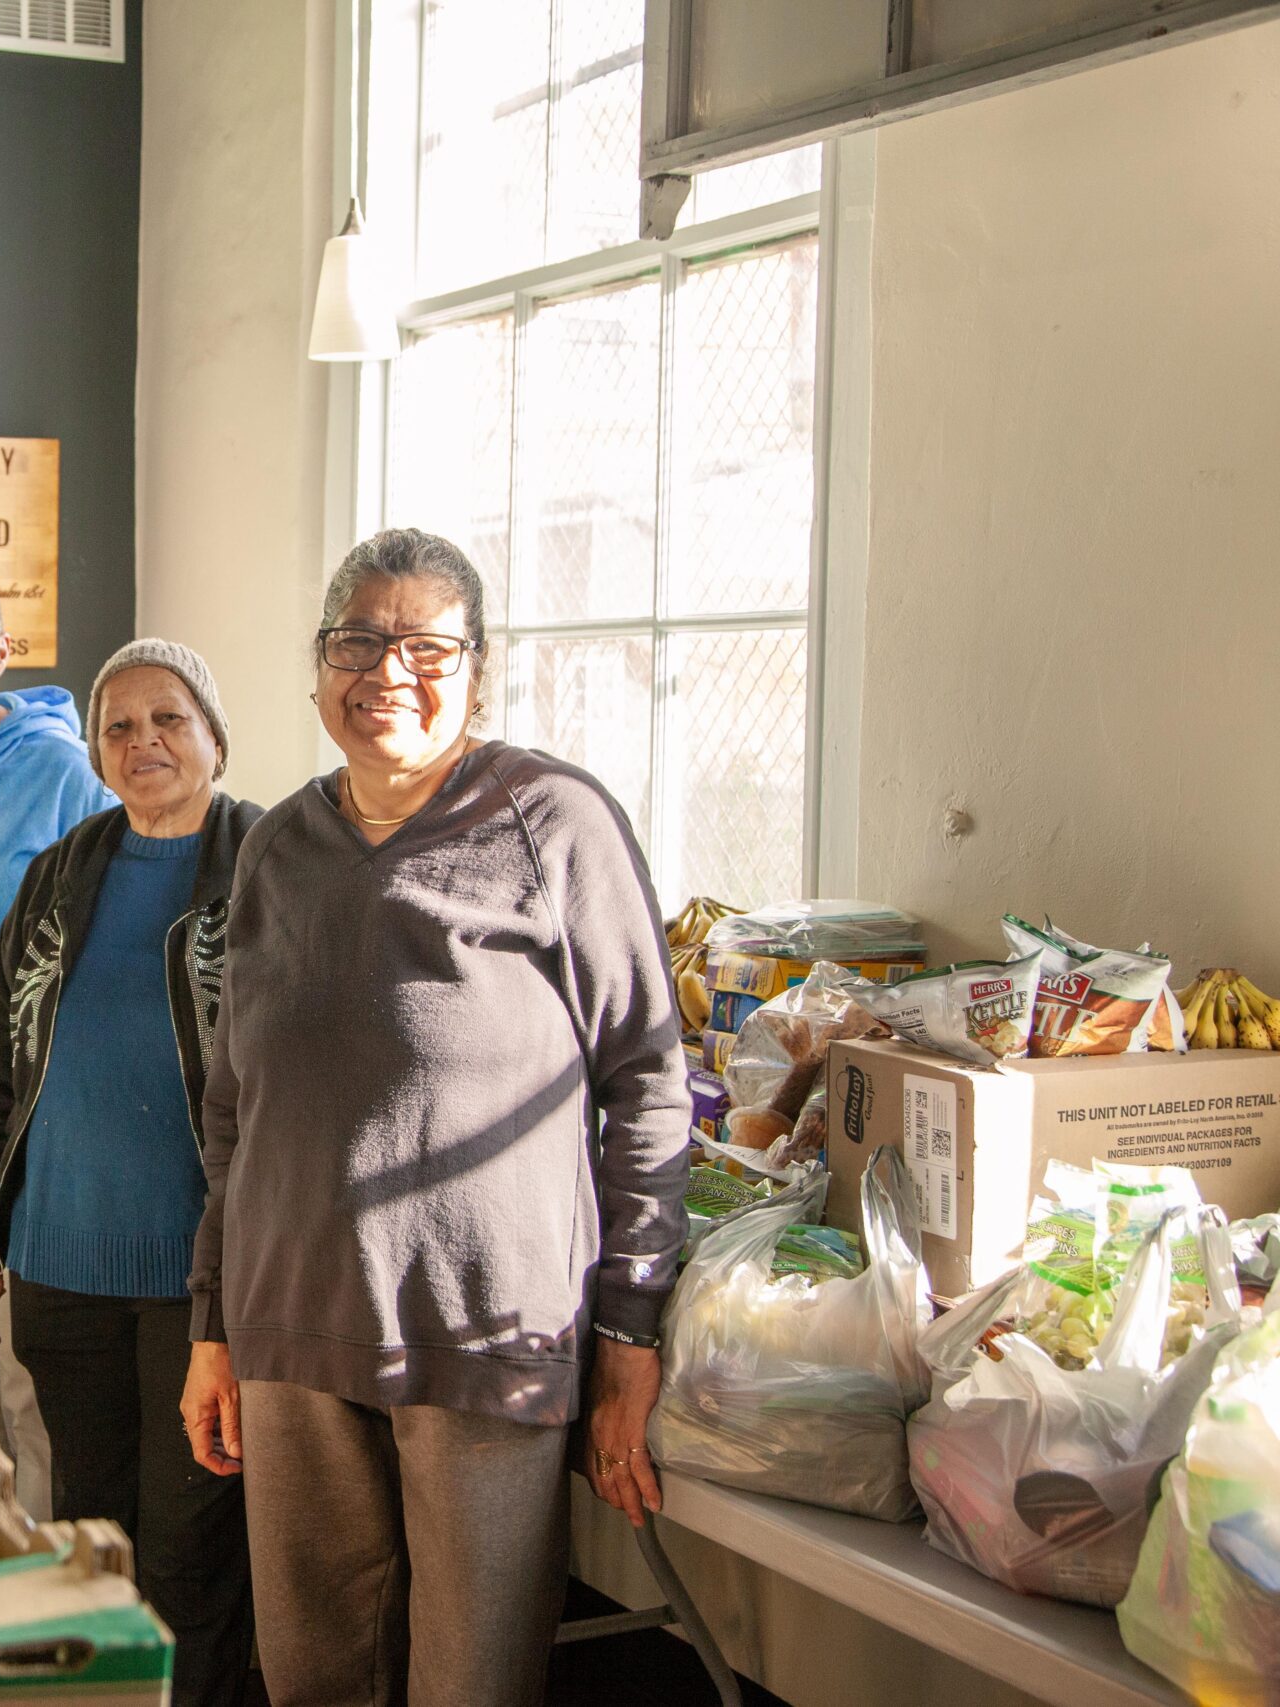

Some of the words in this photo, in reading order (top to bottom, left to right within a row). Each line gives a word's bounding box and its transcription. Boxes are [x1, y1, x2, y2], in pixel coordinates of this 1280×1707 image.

[974, 980, 1008, 995] HERR'S
[901, 1009, 920, 1017] Facts
[1058, 1109, 1086, 1123] THIS
[1089, 1106, 1118, 1121] UNIT
[1120, 1104, 1146, 1118] NOT
[1149, 1099, 1205, 1116] LABELED
[1208, 1096, 1233, 1111] FOR
[1236, 1093, 1277, 1108] RETAIL
[1117, 1136, 1135, 1146] SEE
[1136, 1132, 1184, 1144] INDIVIDUAL
[1186, 1128, 1232, 1141] PACKAGES
[1234, 1126, 1252, 1136] FOR
[1107, 1145, 1165, 1159] INGREDIENTS
[1167, 1143, 1186, 1153] AND
[1187, 1139, 1232, 1152] NUTRITION
[1234, 1137, 1261, 1148] FACTS
[616, 1331, 634, 1343] You
